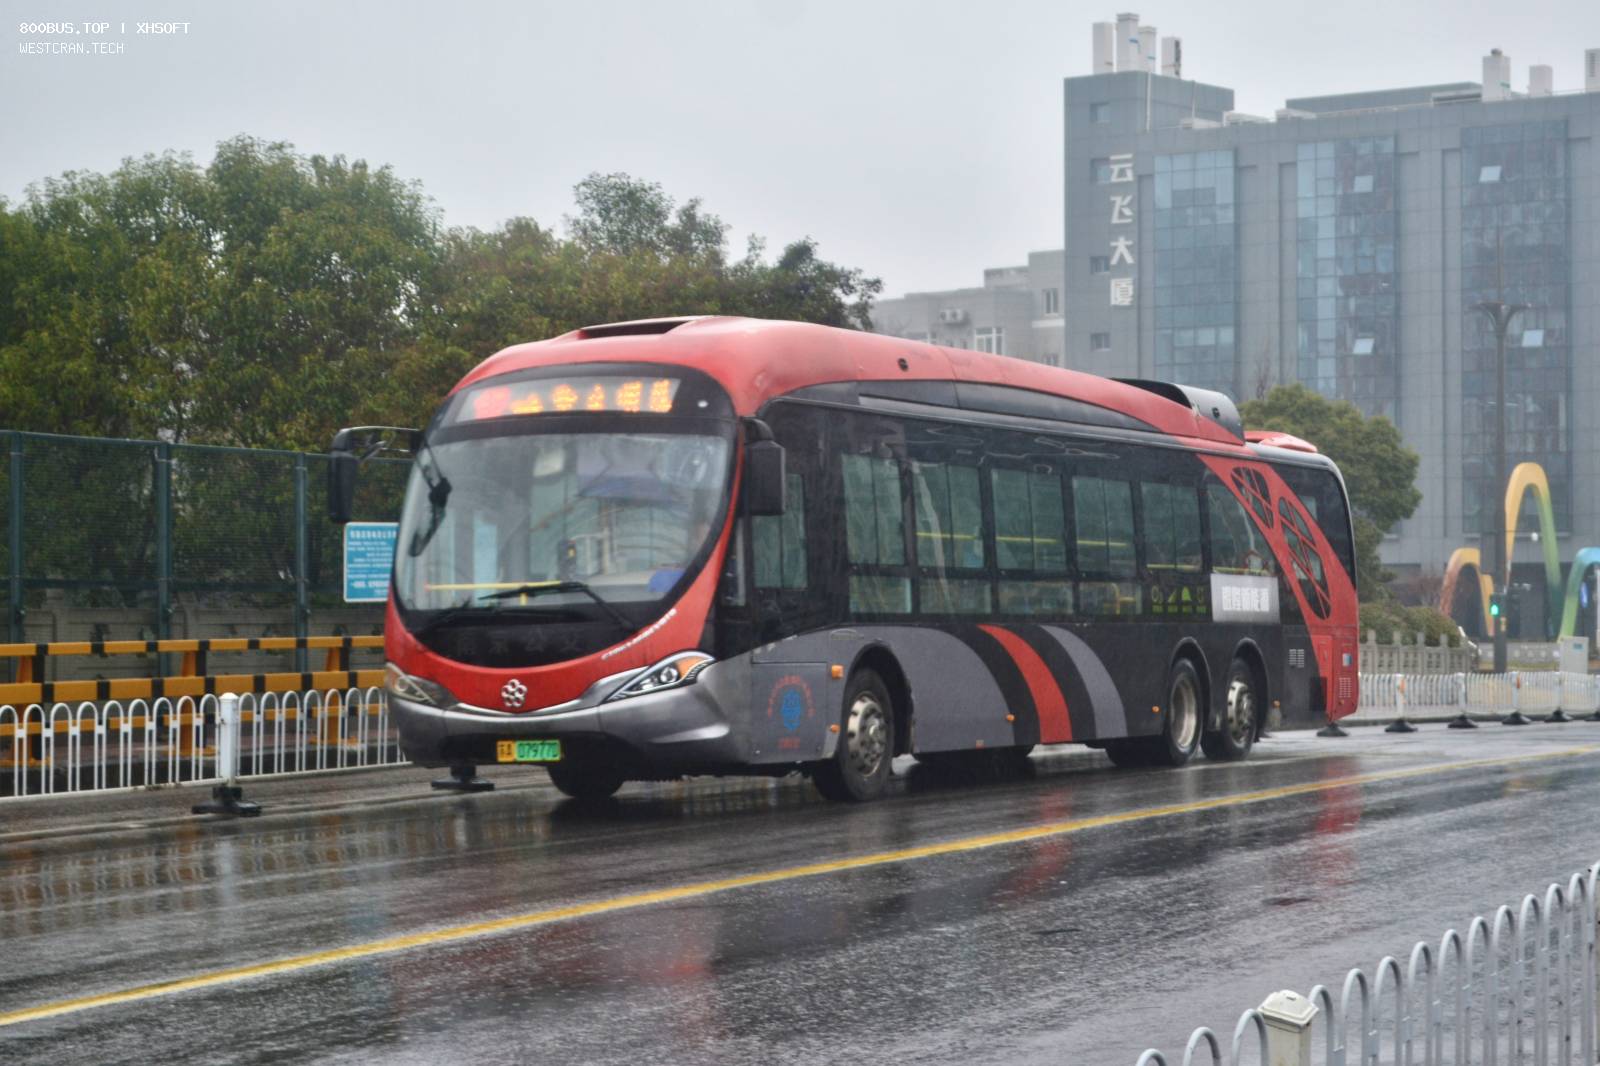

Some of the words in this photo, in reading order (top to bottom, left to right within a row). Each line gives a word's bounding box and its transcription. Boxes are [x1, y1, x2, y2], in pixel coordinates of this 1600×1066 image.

[1109, 153, 1135, 306] 云飞大厦
[1222, 586, 1269, 612] 新能源
